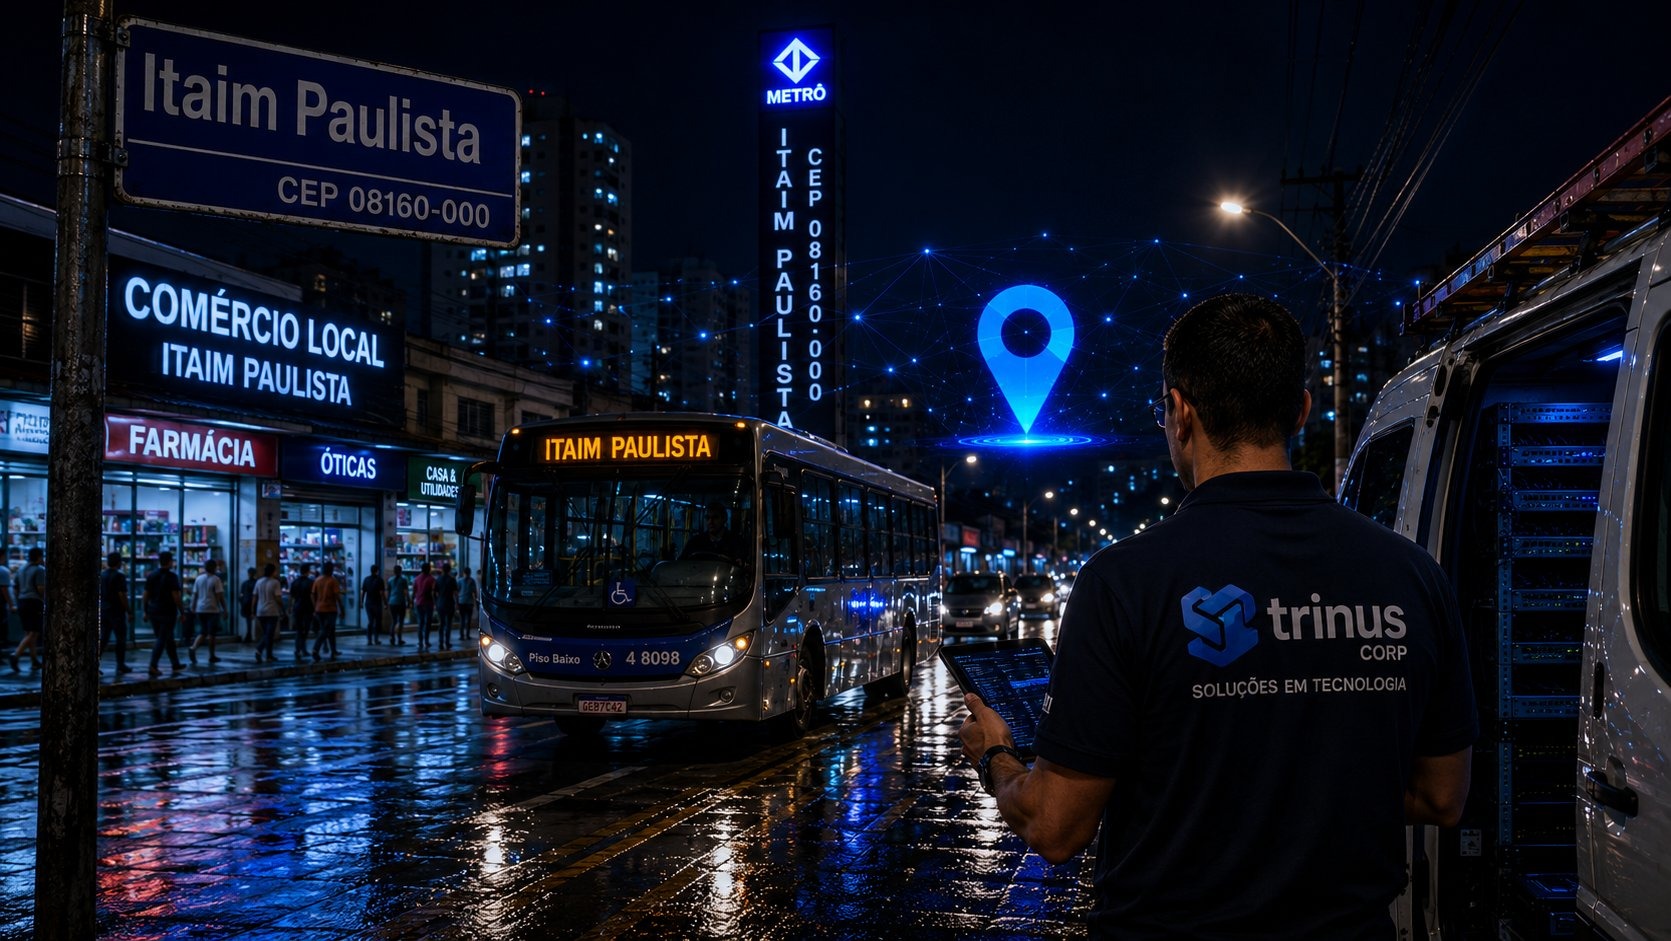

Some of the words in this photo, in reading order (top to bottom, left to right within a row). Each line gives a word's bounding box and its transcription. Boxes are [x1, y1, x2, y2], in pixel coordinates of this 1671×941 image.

[143, 52, 278, 131] Itaim
[296, 79, 481, 165] Paulista
[766, 82, 826, 104] METRÔ
[774, 128, 794, 230] ITAIM
[807, 148, 823, 206] CEP
[277, 175, 339, 208] CEP
[348, 185, 490, 229] 08160-000
[124, 276, 300, 350] COMÉRCIO
[307, 318, 385, 368] LOCAL
[775, 248, 794, 428] PAULISTA
[162, 342, 234, 387] ITAIM
[243, 356, 352, 406] PAULISTA
[129, 424, 256, 468] FARMÁCIA
[320, 446, 377, 480] ÓTICAS
[545, 436, 601, 461] ITAIM
[611, 434, 711, 460] PAULISTA
[426, 465, 449, 483] CASA
[450, 468, 457, 483] &
[1267, 592, 1407, 641] trinus
[528, 652, 549, 664] Piso
[552, 653, 581, 666] Baixo
[625, 650, 636, 665] 4
[641, 650, 680, 666] 8098
[1359, 645, 1408, 661] CORP
[1192, 676, 1278, 699] SOLUÇÕES
[1284, 678, 1308, 694] EM
[1312, 676, 1407, 693] TECNOLOGIA
